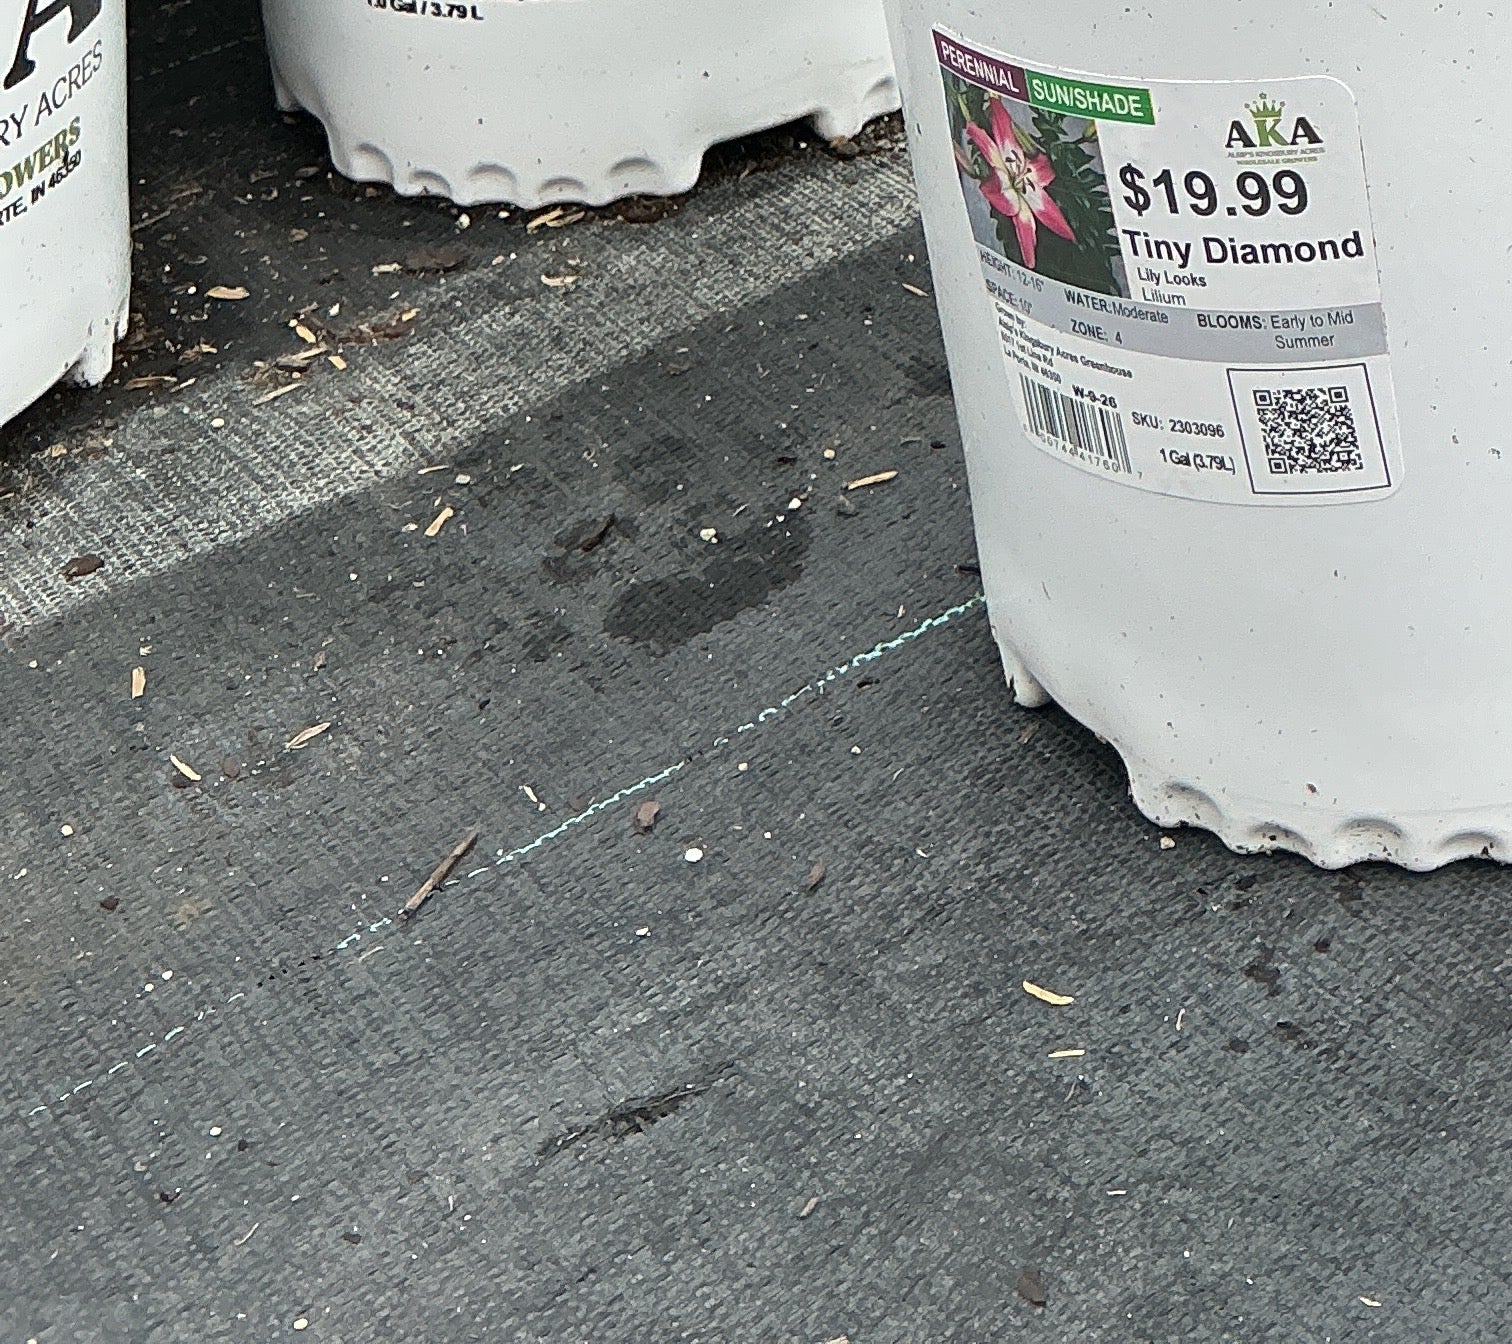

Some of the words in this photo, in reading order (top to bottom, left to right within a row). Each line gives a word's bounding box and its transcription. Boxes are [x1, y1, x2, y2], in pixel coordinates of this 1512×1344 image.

[431, 0, 467, 19] 3.79
[471, 4, 485, 21] L
[941, 40, 1020, 94] PERENNIAL
[35, 39, 102, 128] ACRES
[1032, 76, 1144, 118] SUN/SHADE
[1225, 116, 1325, 149] AKA
[1118, 163, 1309, 218] $19.99
[1122, 228, 1191, 269] Tiny
[1202, 230, 1363, 265] Diamond
[1137, 265, 1163, 288] Lily
[1165, 268, 1207, 288] Looks
[1141, 286, 1187, 307] Lilium
[1070, 318, 1109, 343] ZONE:
[1115, 331, 1123, 344] 4
[1196, 312, 1267, 330] BLOOMS:
[1270, 313, 1306, 331] Early
[1310, 313, 1325, 327] to
[1328, 310, 1354, 327] Mid
[1275, 332, 1335, 350] Summer
[1131, 411, 1165, 431] SKU:
[1168, 418, 1226, 439] 2303096
[1159, 447, 1167, 463] 1
[1168, 449, 1192, 467] Gal
[1193, 452, 1236, 476] (3.79L)
